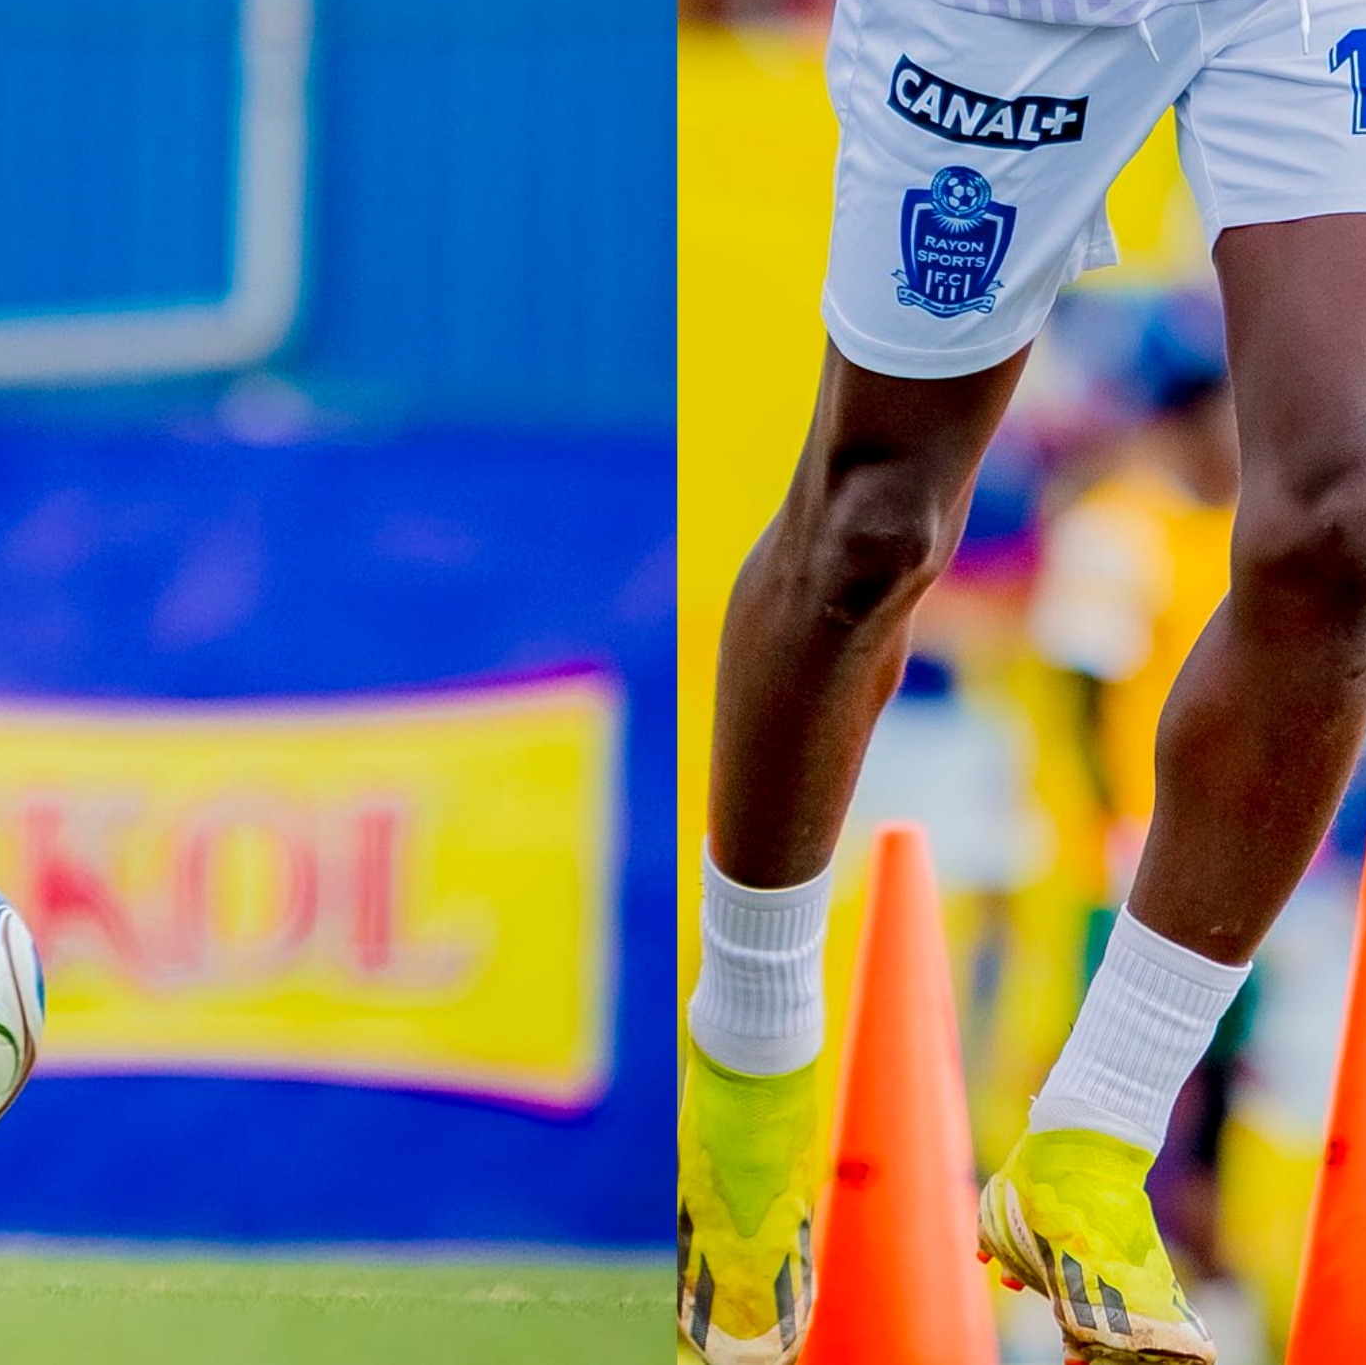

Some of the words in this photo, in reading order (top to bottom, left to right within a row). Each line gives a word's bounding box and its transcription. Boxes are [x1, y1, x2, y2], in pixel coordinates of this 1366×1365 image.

[895, 68, 1078, 142] CANAL+
[924, 234, 984, 253] RAYON
[916, 249, 987, 268] SPORTS
